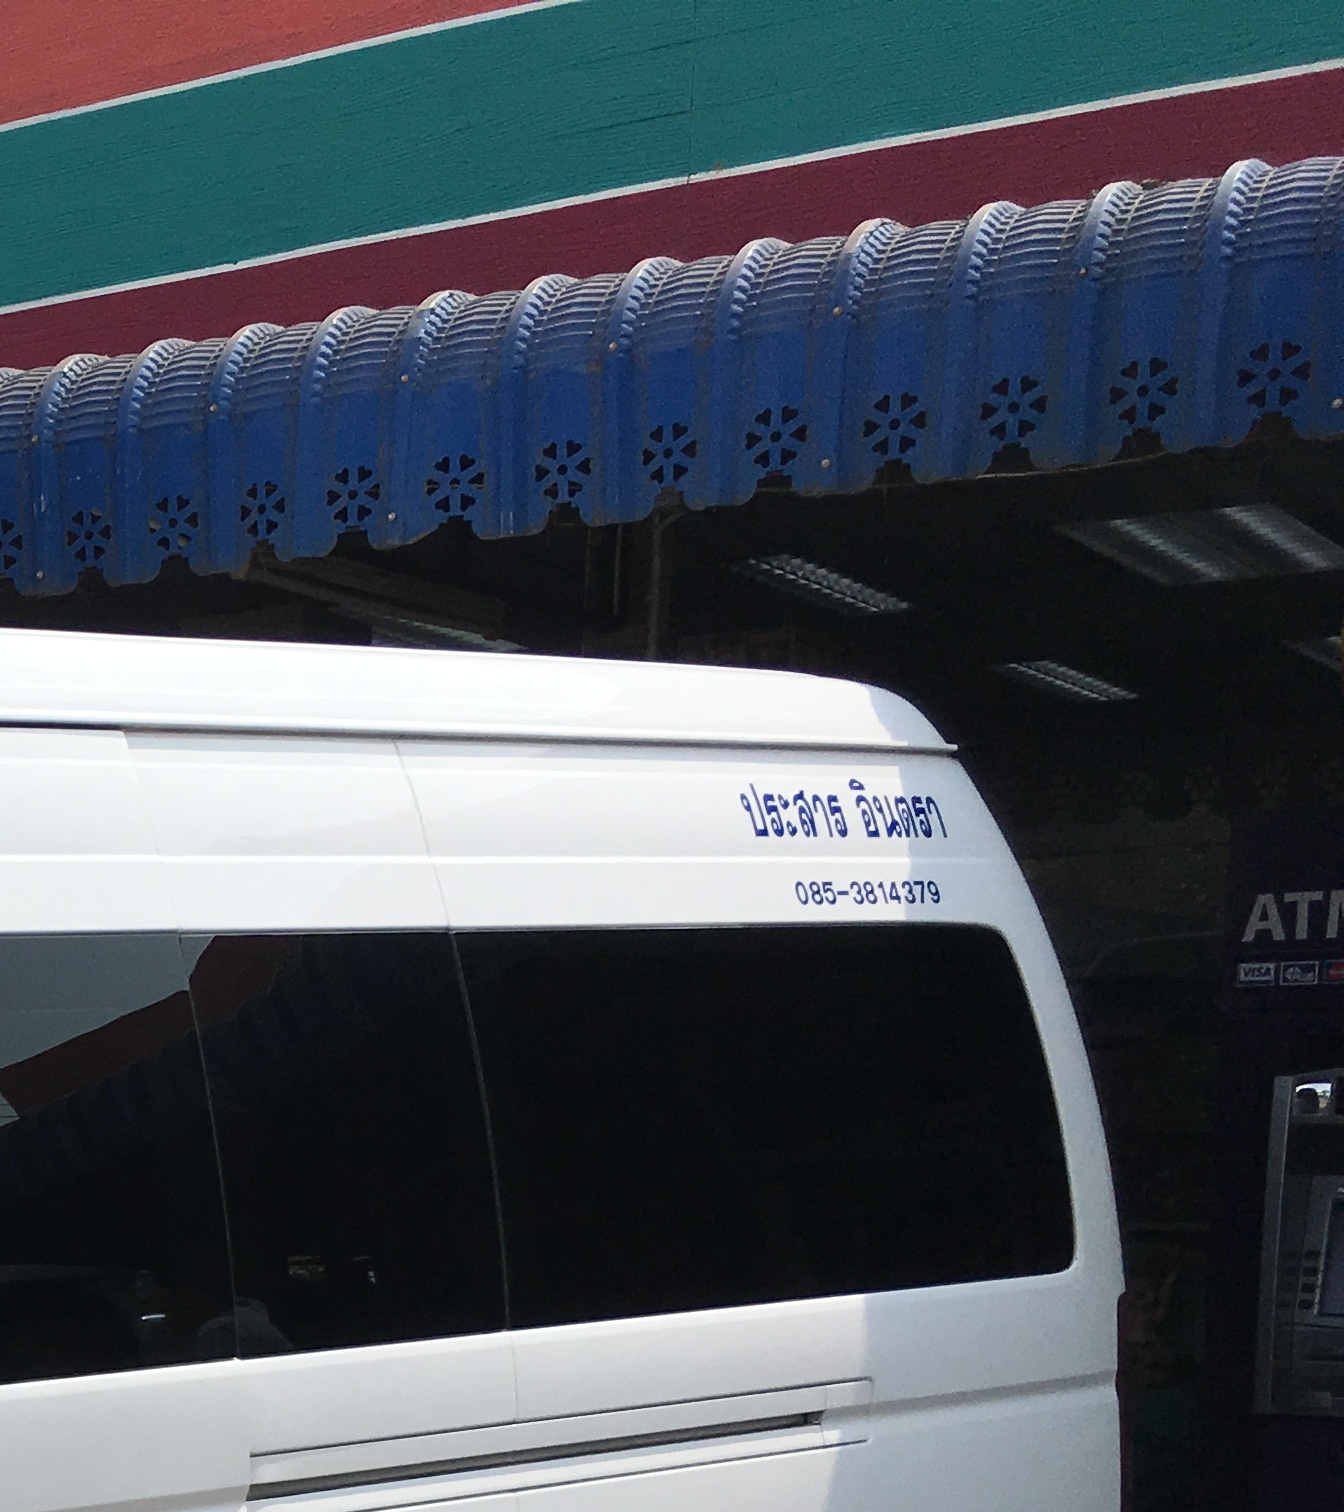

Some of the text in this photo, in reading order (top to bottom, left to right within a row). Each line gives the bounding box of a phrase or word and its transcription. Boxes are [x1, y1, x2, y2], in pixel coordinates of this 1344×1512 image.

[739, 782, 848, 838] ประสาร
[795, 879, 941, 905] 085-3814379
[1242, 966, 1272, 978] VISA
